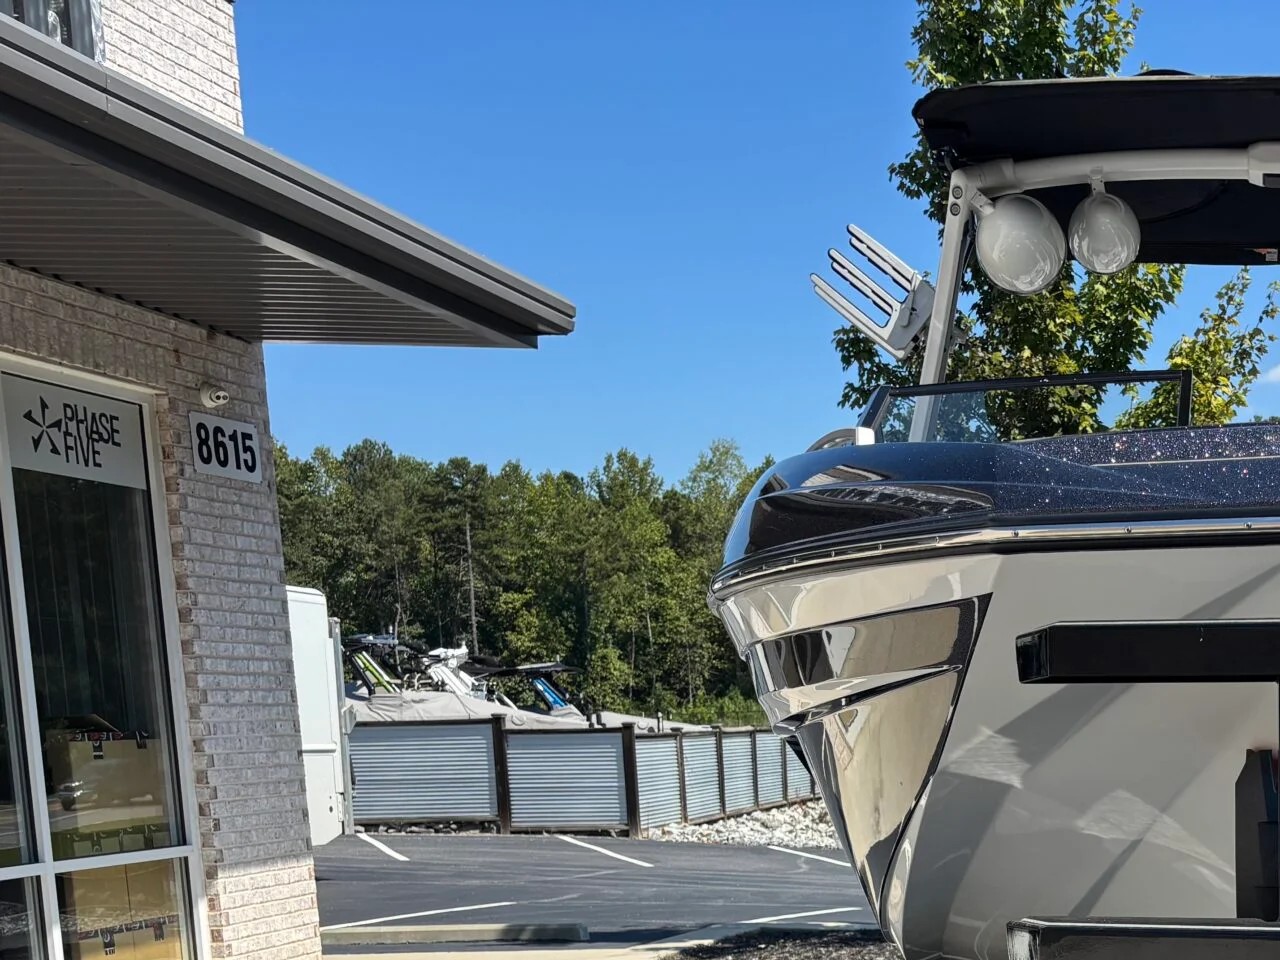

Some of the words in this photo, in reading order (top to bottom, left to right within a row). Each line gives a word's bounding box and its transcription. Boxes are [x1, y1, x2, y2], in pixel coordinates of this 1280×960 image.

[63, 402, 120, 447] PHASE
[64, 432, 102, 468] FIVE
[195, 422, 257, 473] 8615
